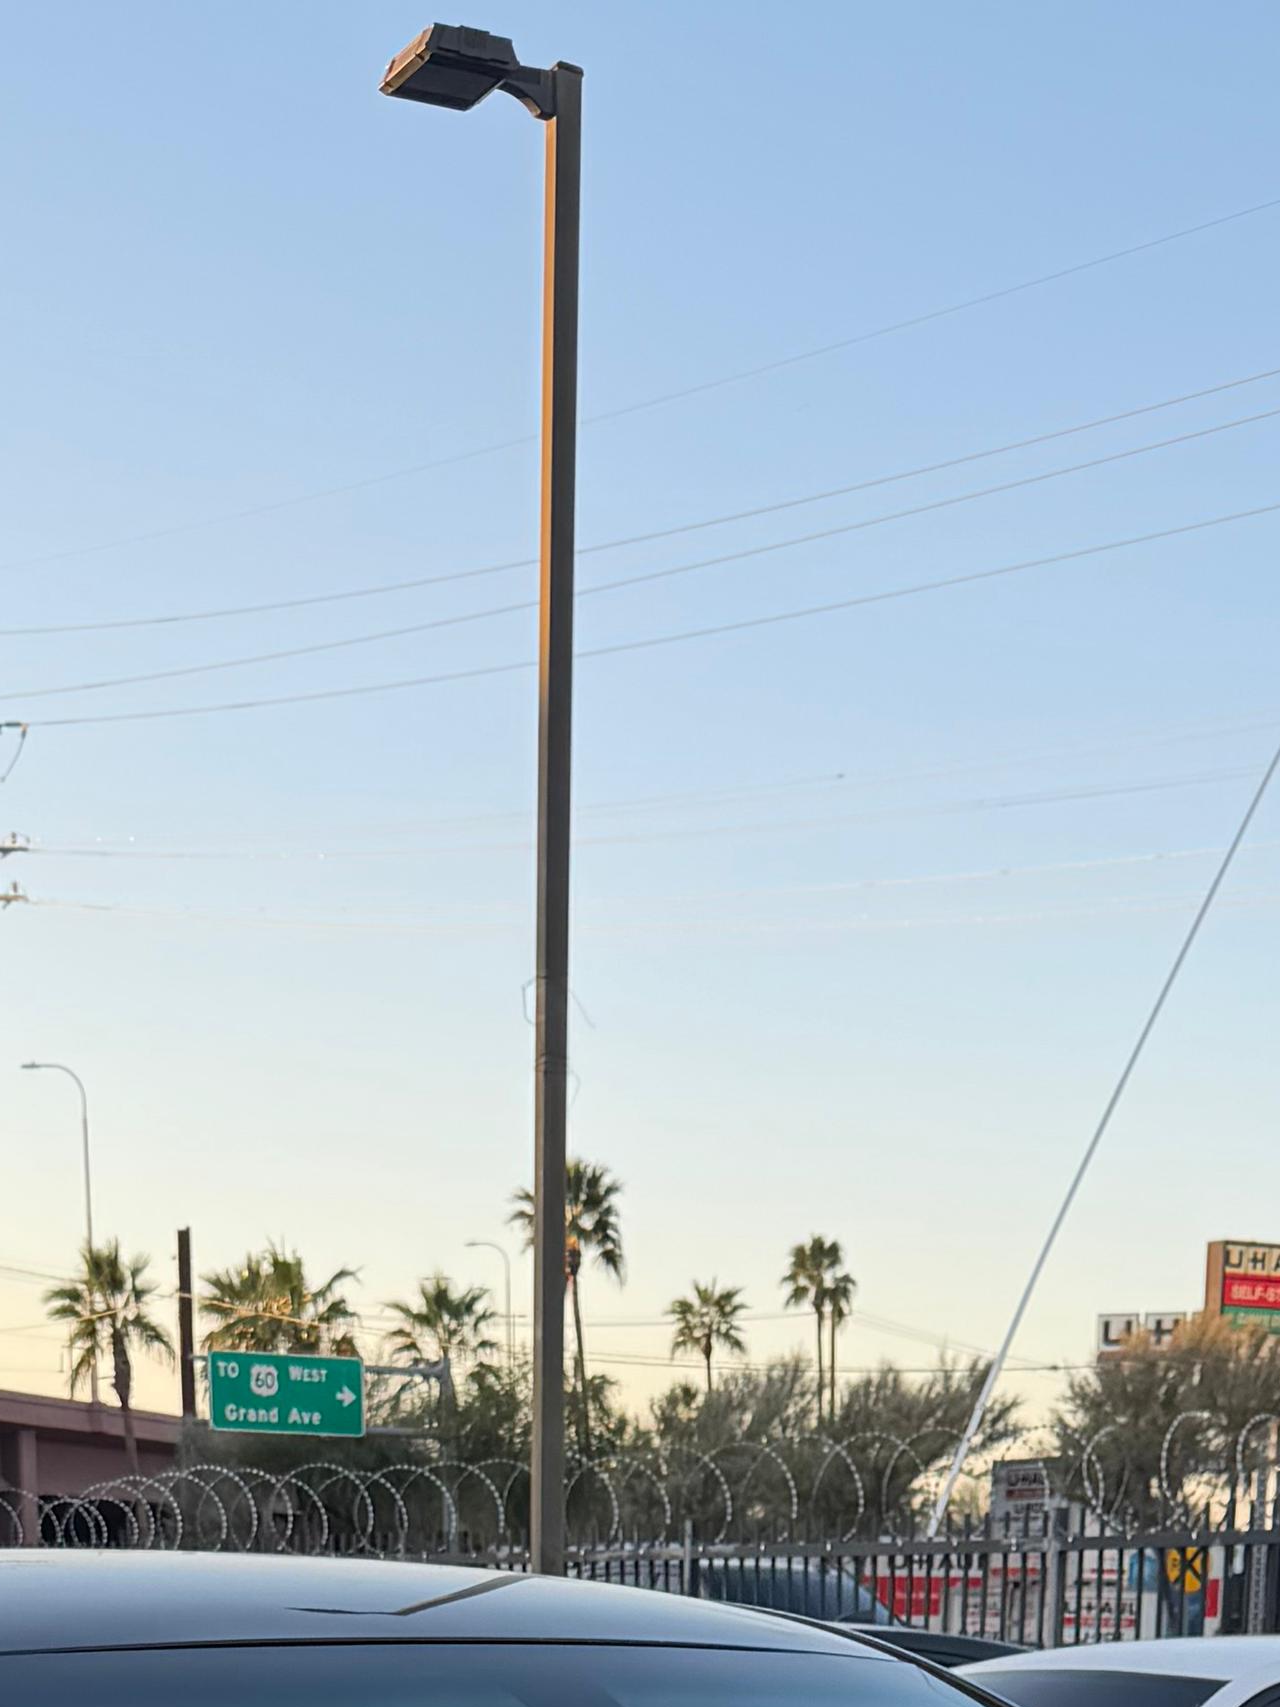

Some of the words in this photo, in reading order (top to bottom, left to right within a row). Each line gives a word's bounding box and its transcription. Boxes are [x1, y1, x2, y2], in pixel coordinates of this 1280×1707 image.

[217, 1361, 239, 1378] TO
[255, 1371, 276, 1389] 60
[224, 1403, 279, 1424] Grand
[287, 1407, 322, 1425] Ave
